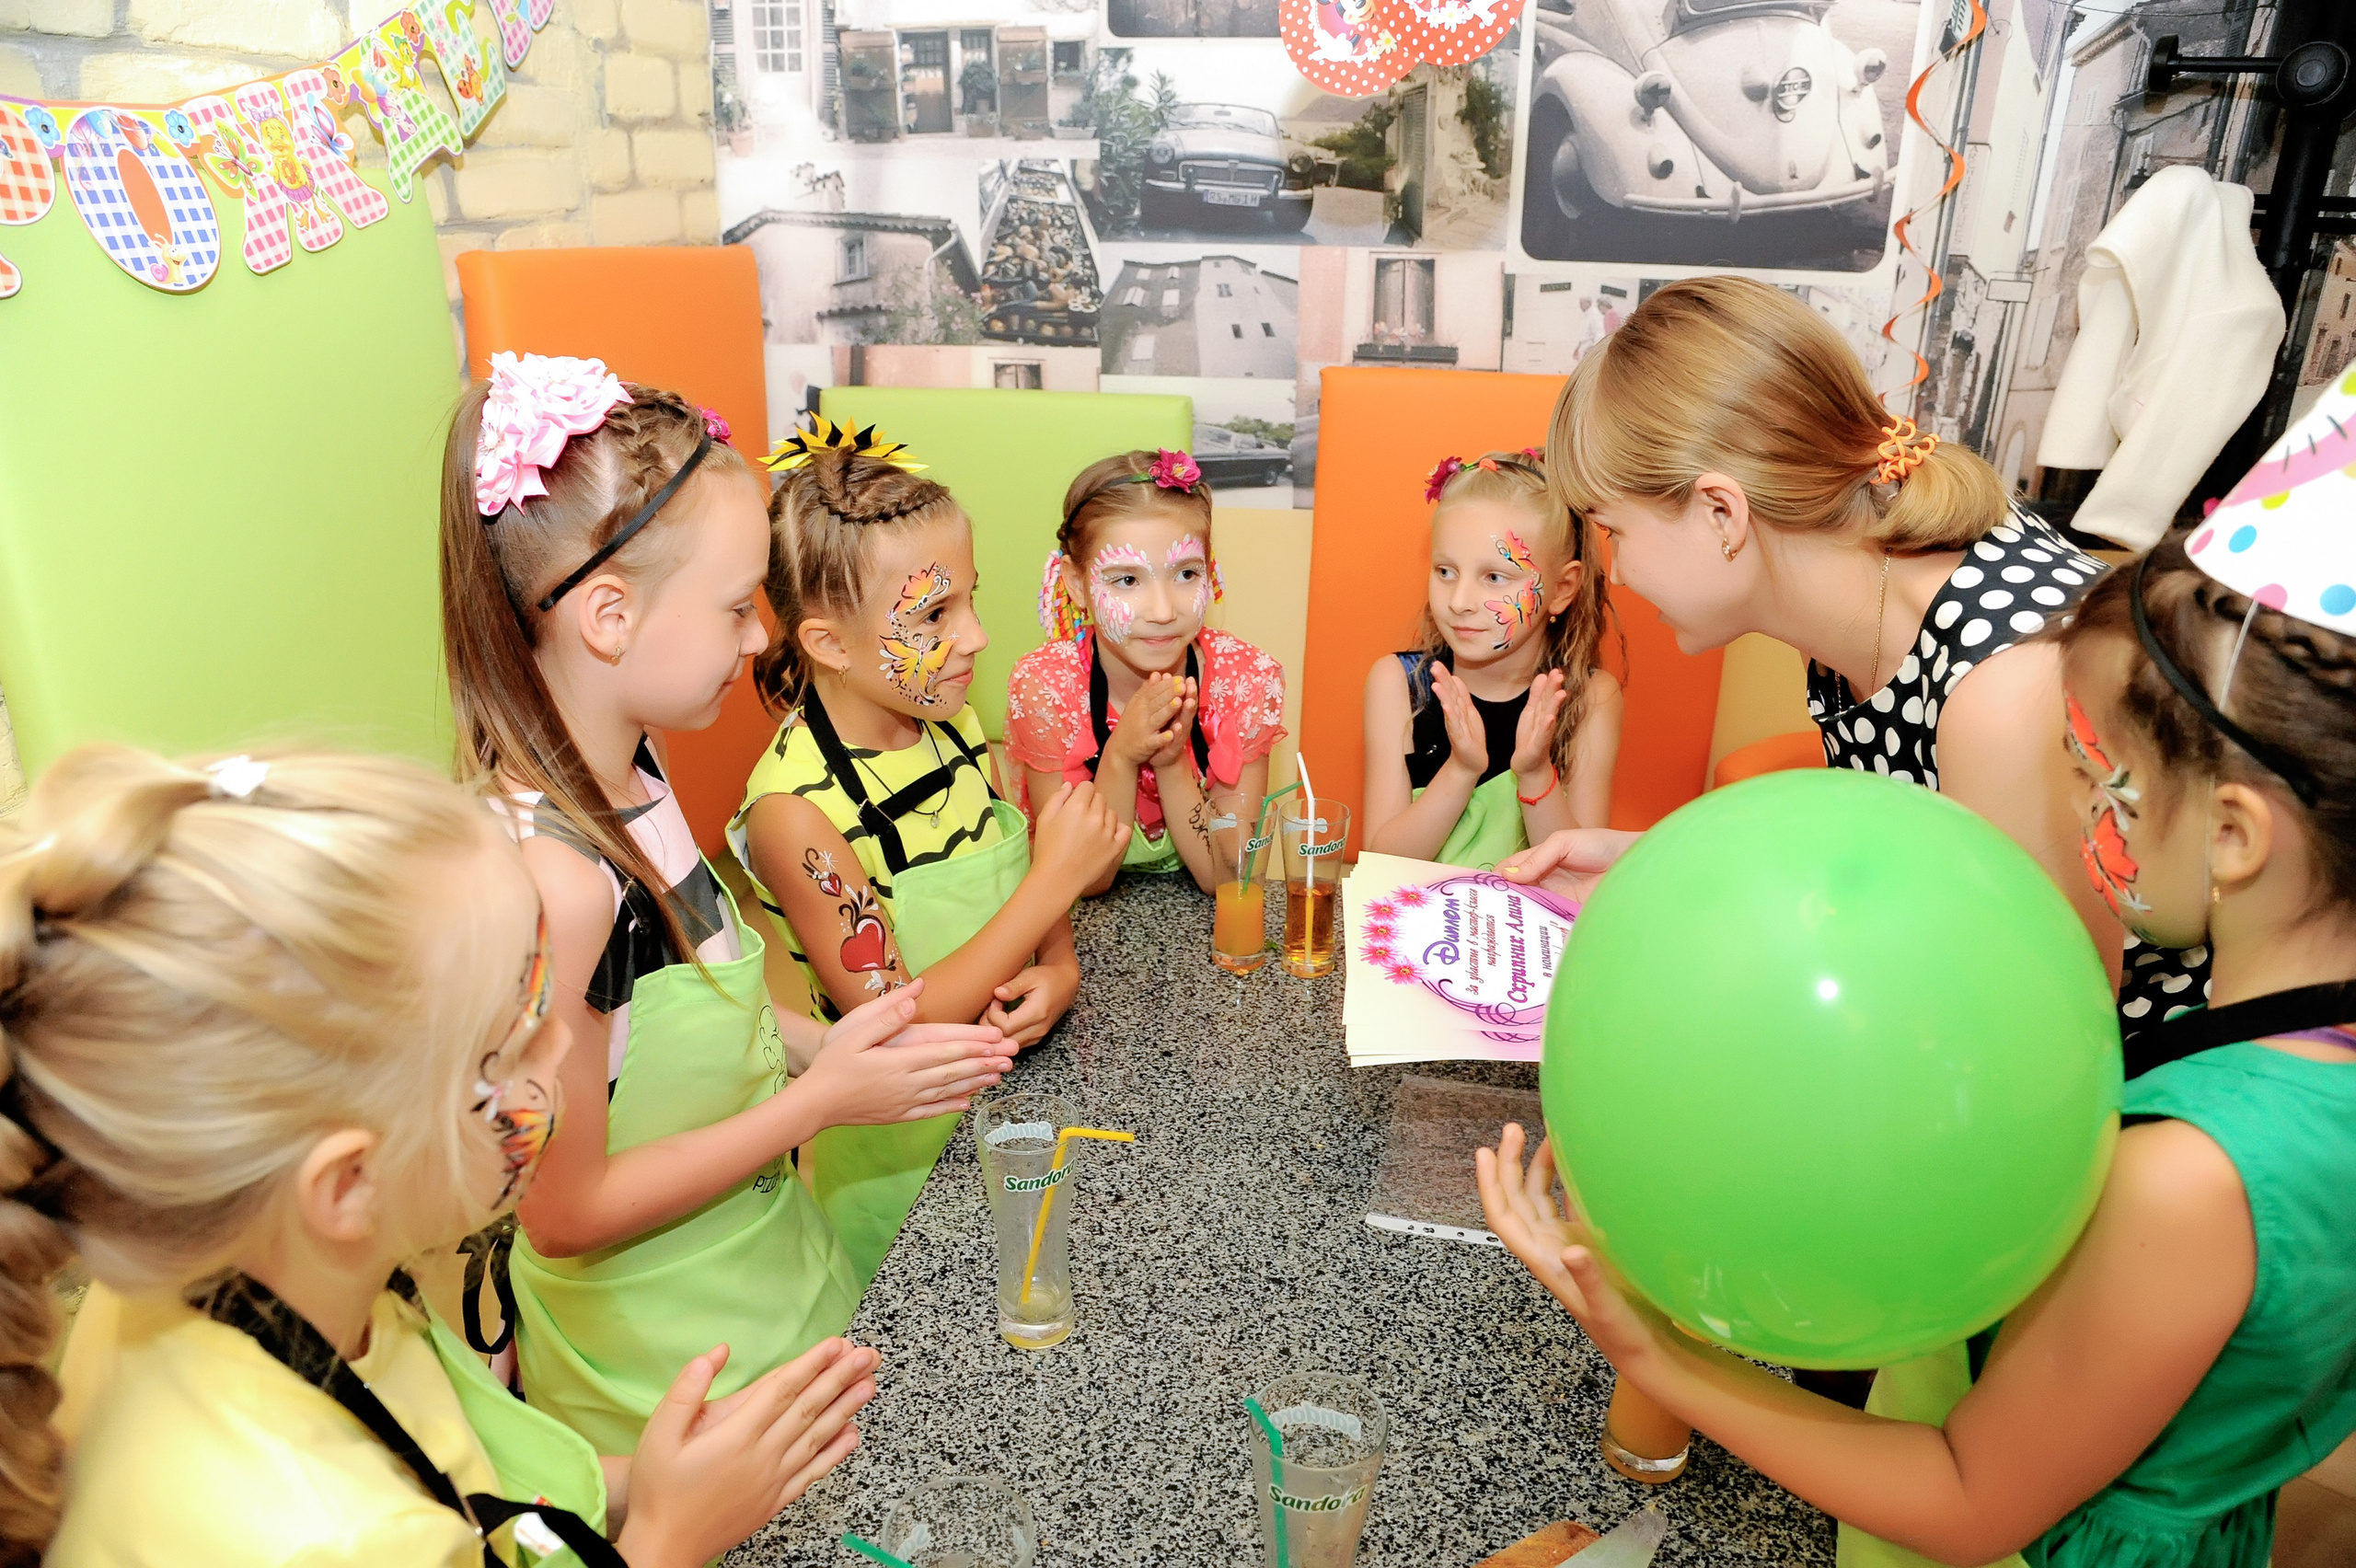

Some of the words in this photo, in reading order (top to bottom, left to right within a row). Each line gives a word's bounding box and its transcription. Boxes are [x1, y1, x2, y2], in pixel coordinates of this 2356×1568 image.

[1423, 898, 1461, 965] Диплом
[1506, 894, 1524, 934] Алина
[1481, 914, 1502, 966] награждается
[1539, 925, 1553, 971] номинации
[1465, 948, 1484, 984] участие
[1507, 935, 1535, 1004] Скрипник
[1465, 985, 1479, 996] За
[1269, 1485, 1367, 1512] Sandora
